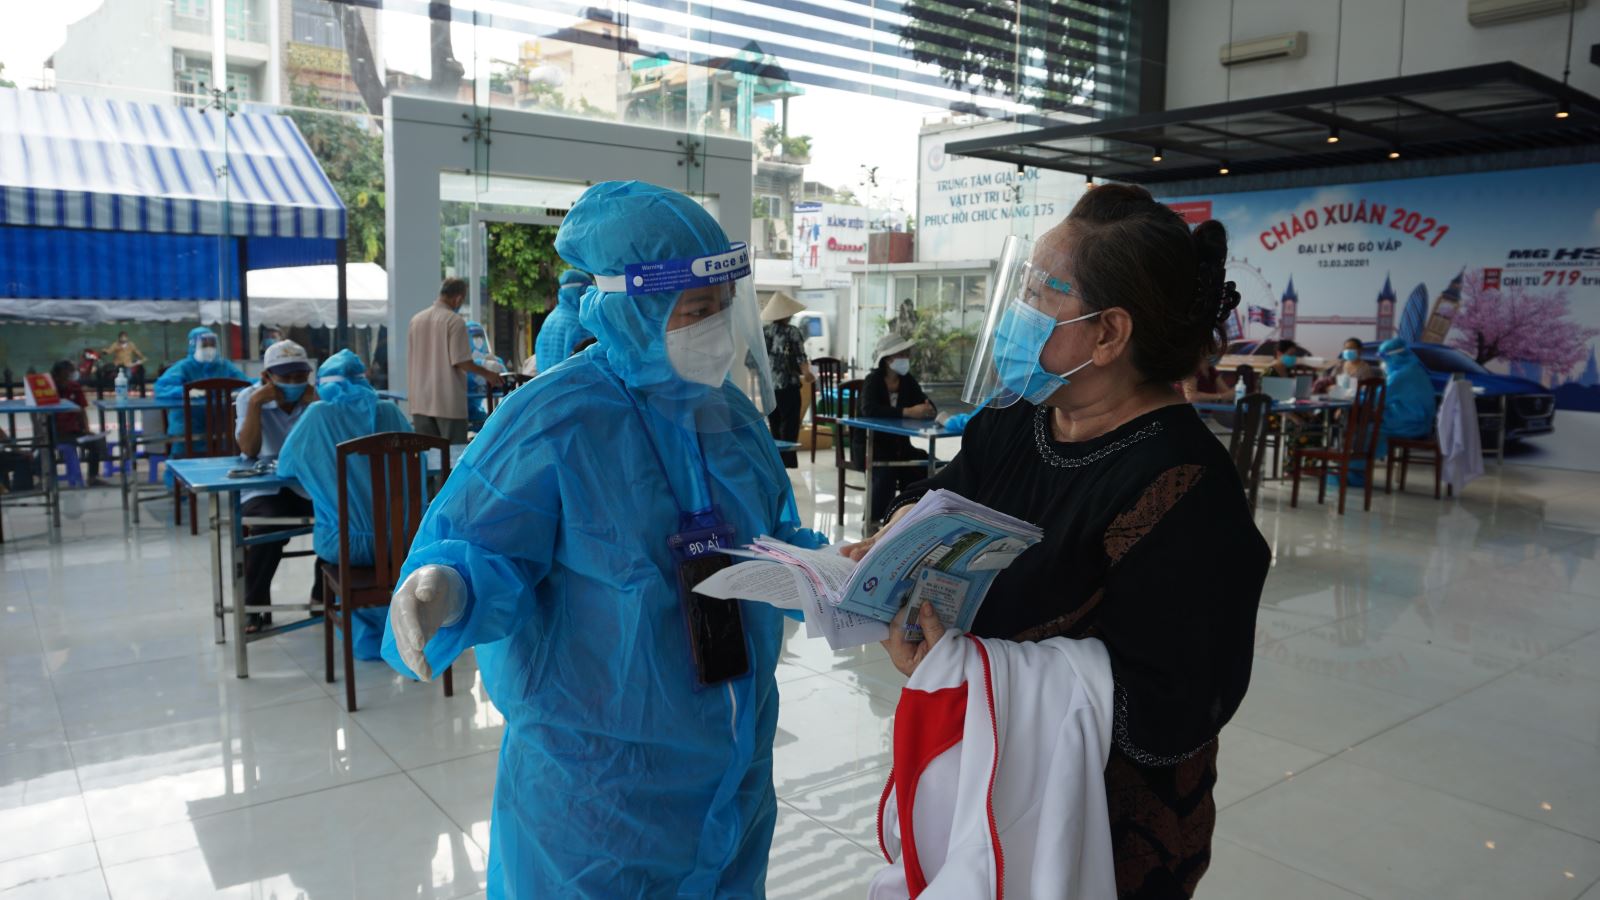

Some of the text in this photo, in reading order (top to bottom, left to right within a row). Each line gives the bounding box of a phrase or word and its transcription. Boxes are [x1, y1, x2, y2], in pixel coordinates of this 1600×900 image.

[937, 178, 968, 192] TRUNG
[971, 173, 992, 189] TÂM
[950, 192, 968, 208] VẬT
[924, 213, 949, 227] PHỤC
[1033, 202, 1054, 216] 175
[1259, 200, 1450, 252] CHÀO XUÂN 2021
[1337, 242, 1355, 253] MG
[1508, 249, 1550, 259] MG
[705, 257, 736, 272] Face
[1541, 270, 1581, 287] 719
